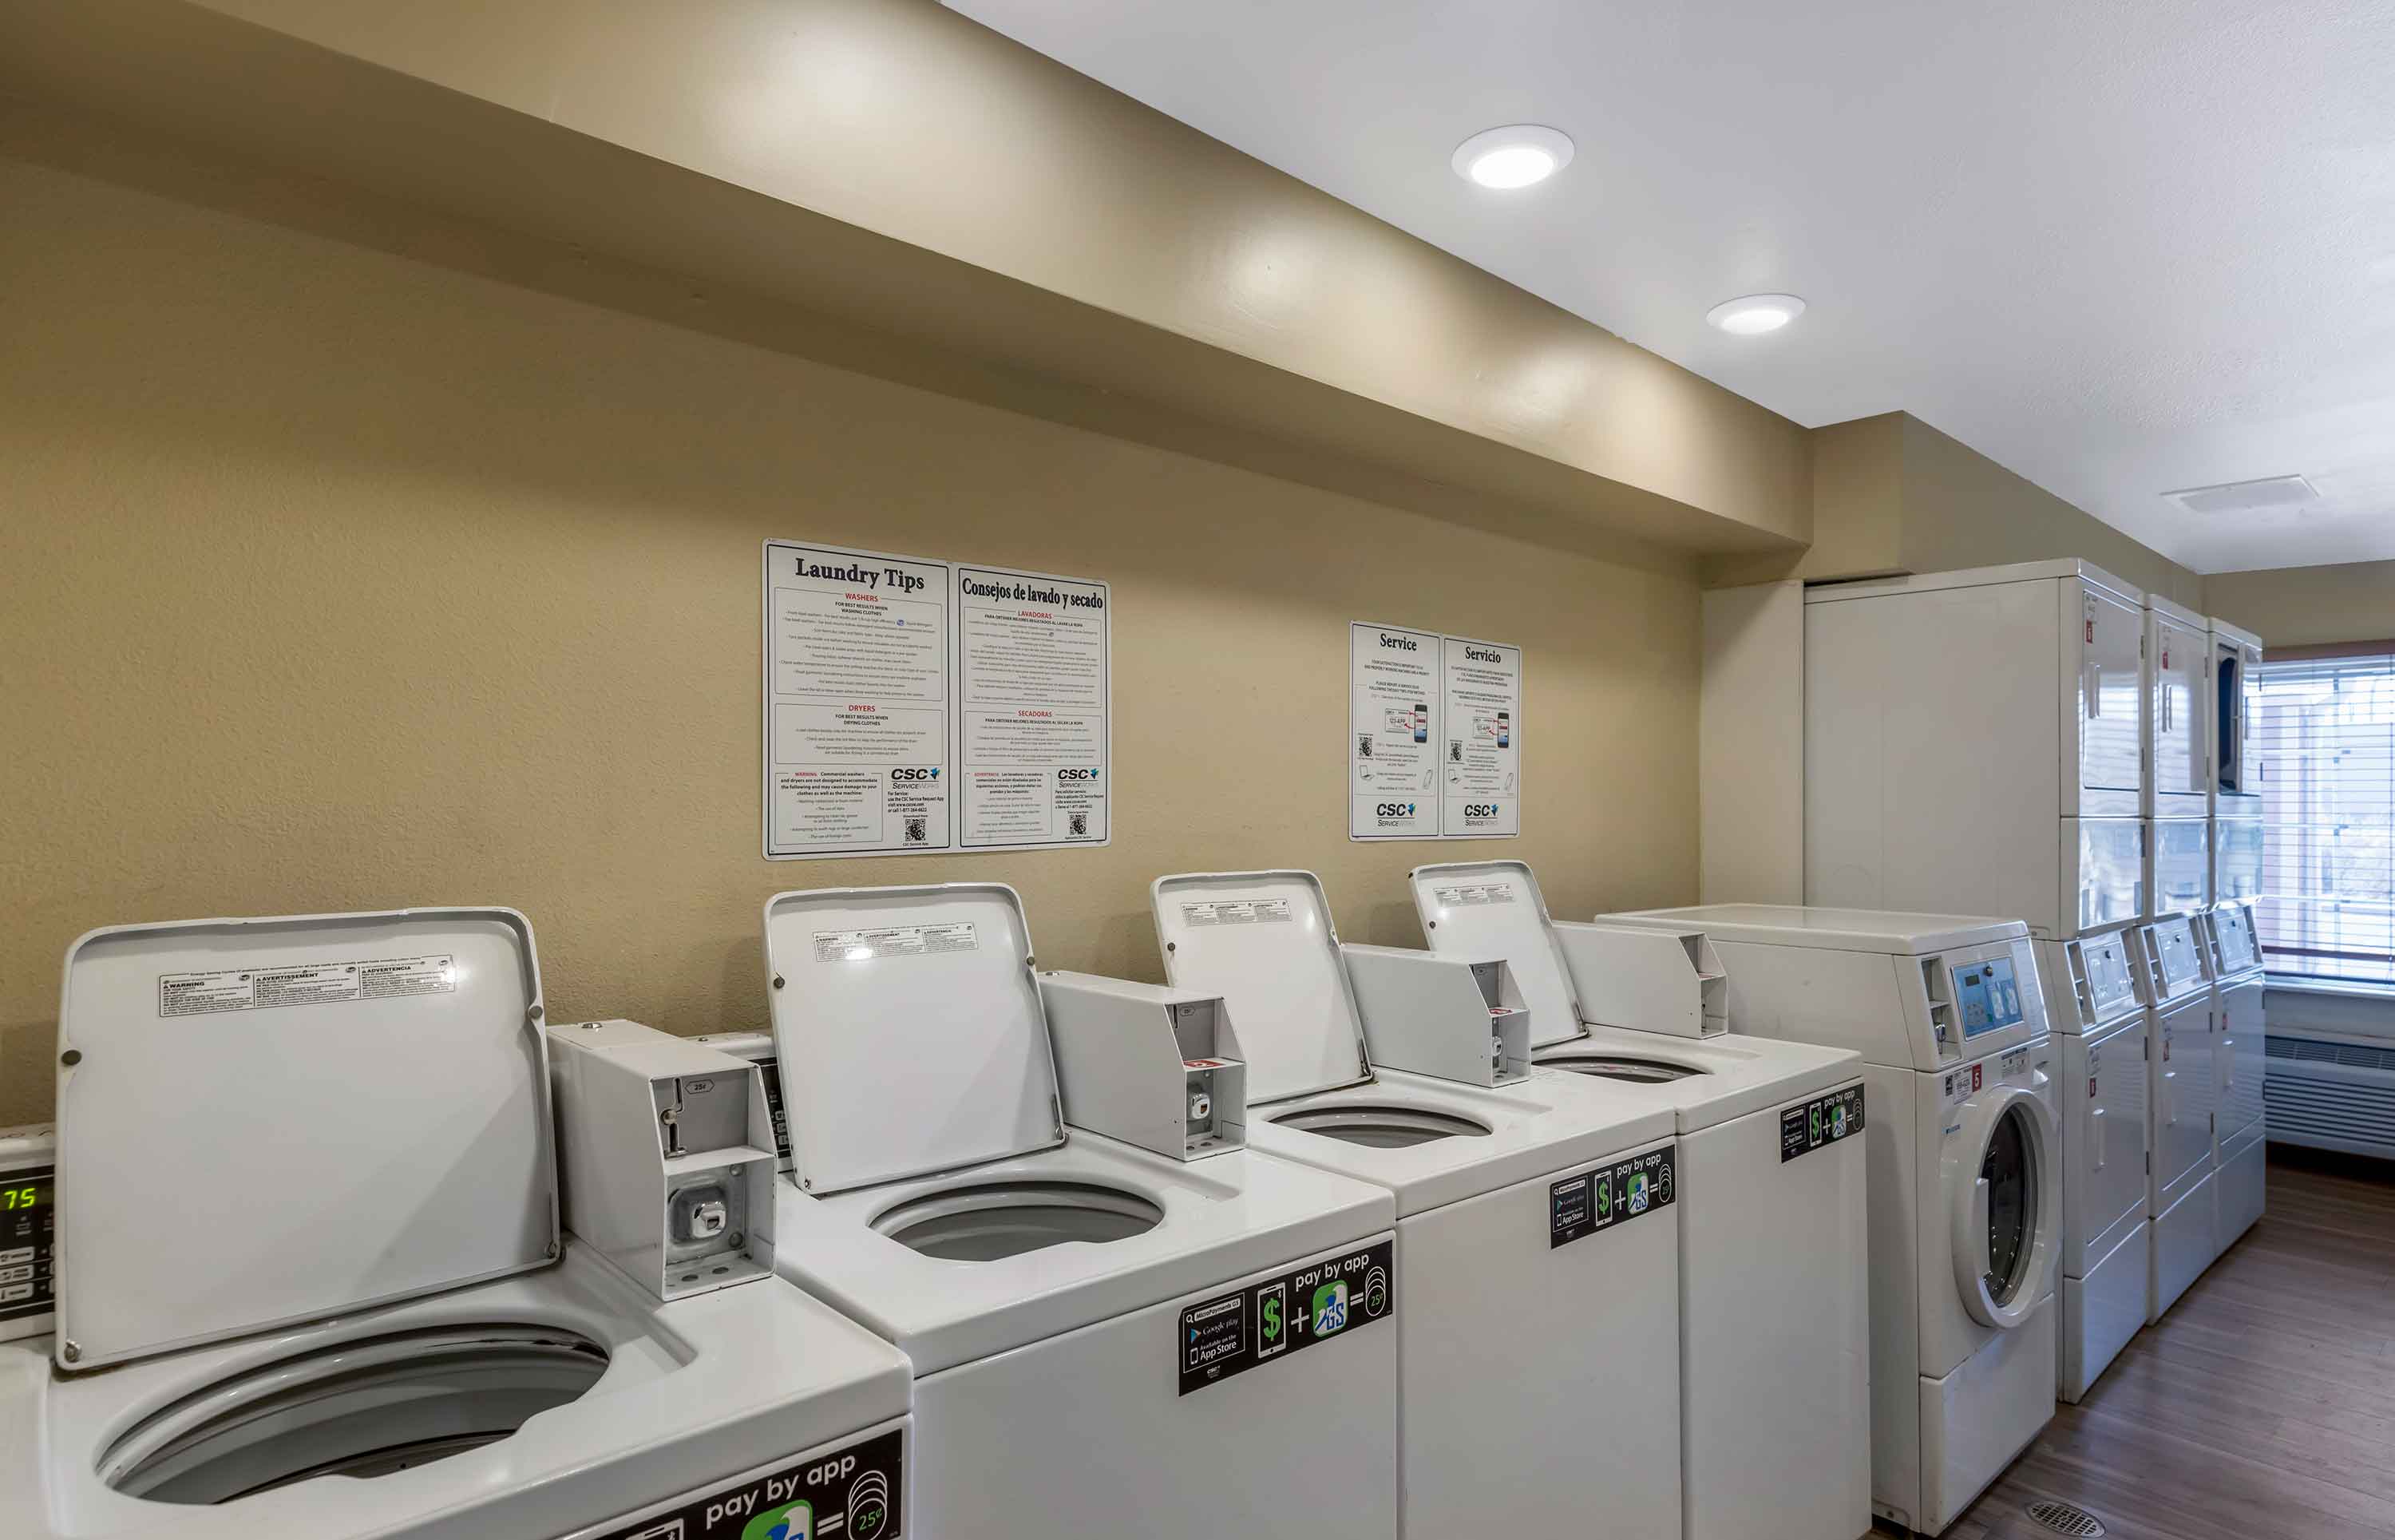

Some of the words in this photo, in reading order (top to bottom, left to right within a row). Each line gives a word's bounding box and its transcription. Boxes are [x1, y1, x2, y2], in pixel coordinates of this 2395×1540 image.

[795, 557, 880, 589] Laundry
[884, 568, 924, 593] Tips
[845, 593, 878, 602] WASHERS
[962, 577, 1011, 602] Consejos
[1013, 584, 1026, 600] de
[1027, 584, 1060, 604] lavado
[1063, 594, 1069, 609] y
[1071, 592, 1103, 608] secado
[1018, 609, 1052, 620] LAVADORAS
[1380, 632, 1417, 651] Service
[1465, 646, 1501, 663] Servicio
[891, 768, 928, 780] CSC
[1058, 769, 1088, 780] CSC
[1376, 803, 1406, 816] CSC
[1464, 804, 1490, 817] CSC
[262, 972, 319, 981] AVERTISSEMENT
[1974, 1072, 1980, 1087] 5
[1824, 1096, 1835, 1110] pay
[1835, 1092, 1843, 1103] by
[1844, 1090, 1855, 1103] app
[1617, 1163, 1633, 1178] pay
[1633, 1158, 1644, 1171] by
[1645, 1153, 1661, 1168] app
[4, 1187, 36, 1209] 75
[1562, 1215, 1572, 1225] App
[1571, 1212, 1584, 1221] Store
[1296, 1271, 1321, 1292] pay
[1324, 1261, 1341, 1279] by
[1344, 1253, 1370, 1273] app
[1197, 1303, 1232, 1318] MicroPayments
[1202, 1321, 1224, 1336] Google
[1225, 1317, 1239, 1329] play
[1200, 1339, 1221, 1351] Available
[1200, 1348, 1217, 1361] App
[1217, 1341, 1237, 1356] Store
[706, 1488, 758, 1530] pay
[766, 1475, 799, 1502] by
[806, 1454, 856, 1486] app
[859, 1506, 882, 1531] 25¢
